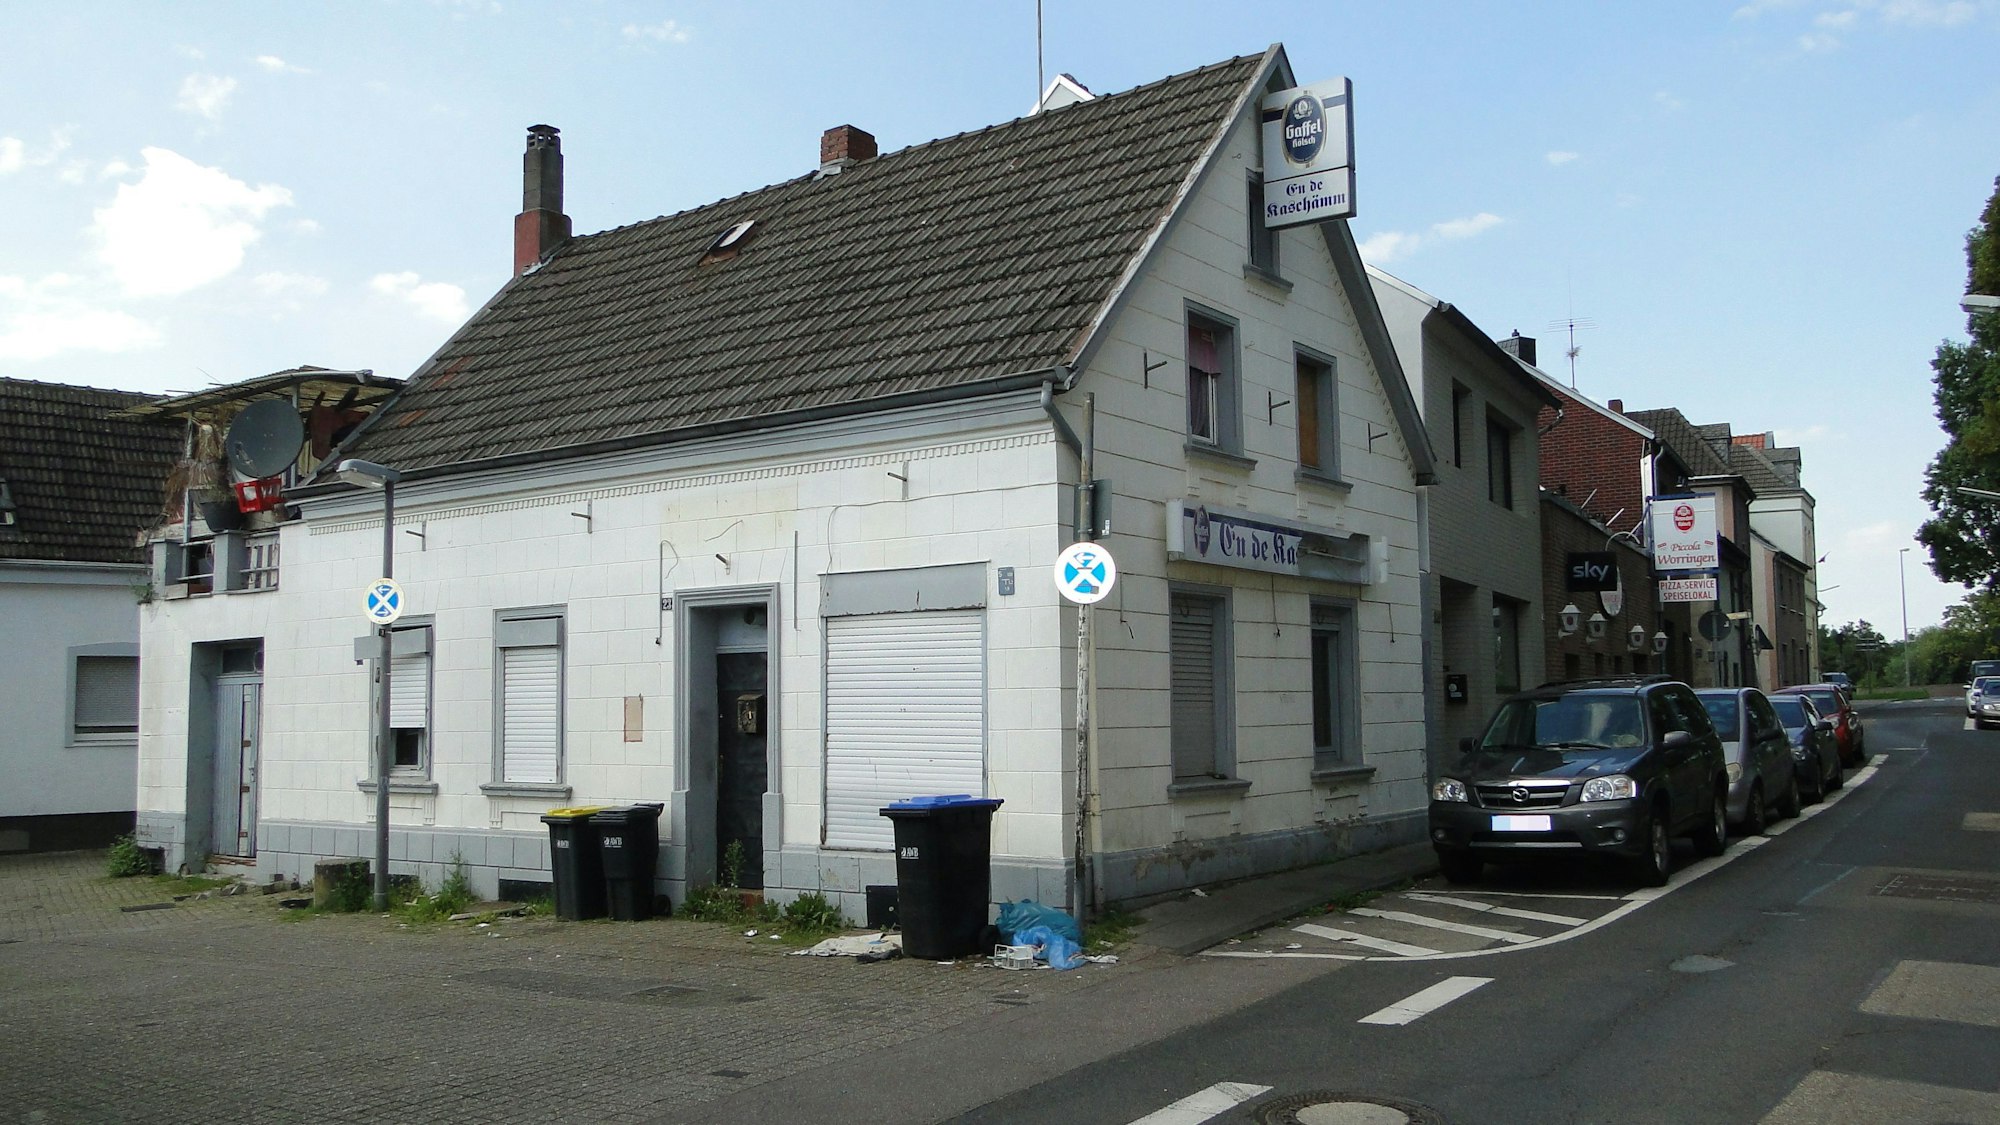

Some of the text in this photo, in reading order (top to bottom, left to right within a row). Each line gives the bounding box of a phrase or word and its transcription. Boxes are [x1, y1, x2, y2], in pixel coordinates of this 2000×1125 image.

[1285, 118, 1323, 140] Gaffel
[1292, 136, 1316, 148] Kölsch
[1286, 180, 1323, 196] En de
[1267, 193, 1346, 218] Kaschämm
[1251, 531, 1269, 561] de
[1670, 541, 1701, 551] Piccola
[1657, 554, 1716, 566] Worringen
[1572, 561, 1609, 581] sky
[1660, 580, 1714, 590] PIZZA-SERVICE
[1663, 591, 1712, 601] SPEISELOKAL
[662, 598, 672, 610] 23
